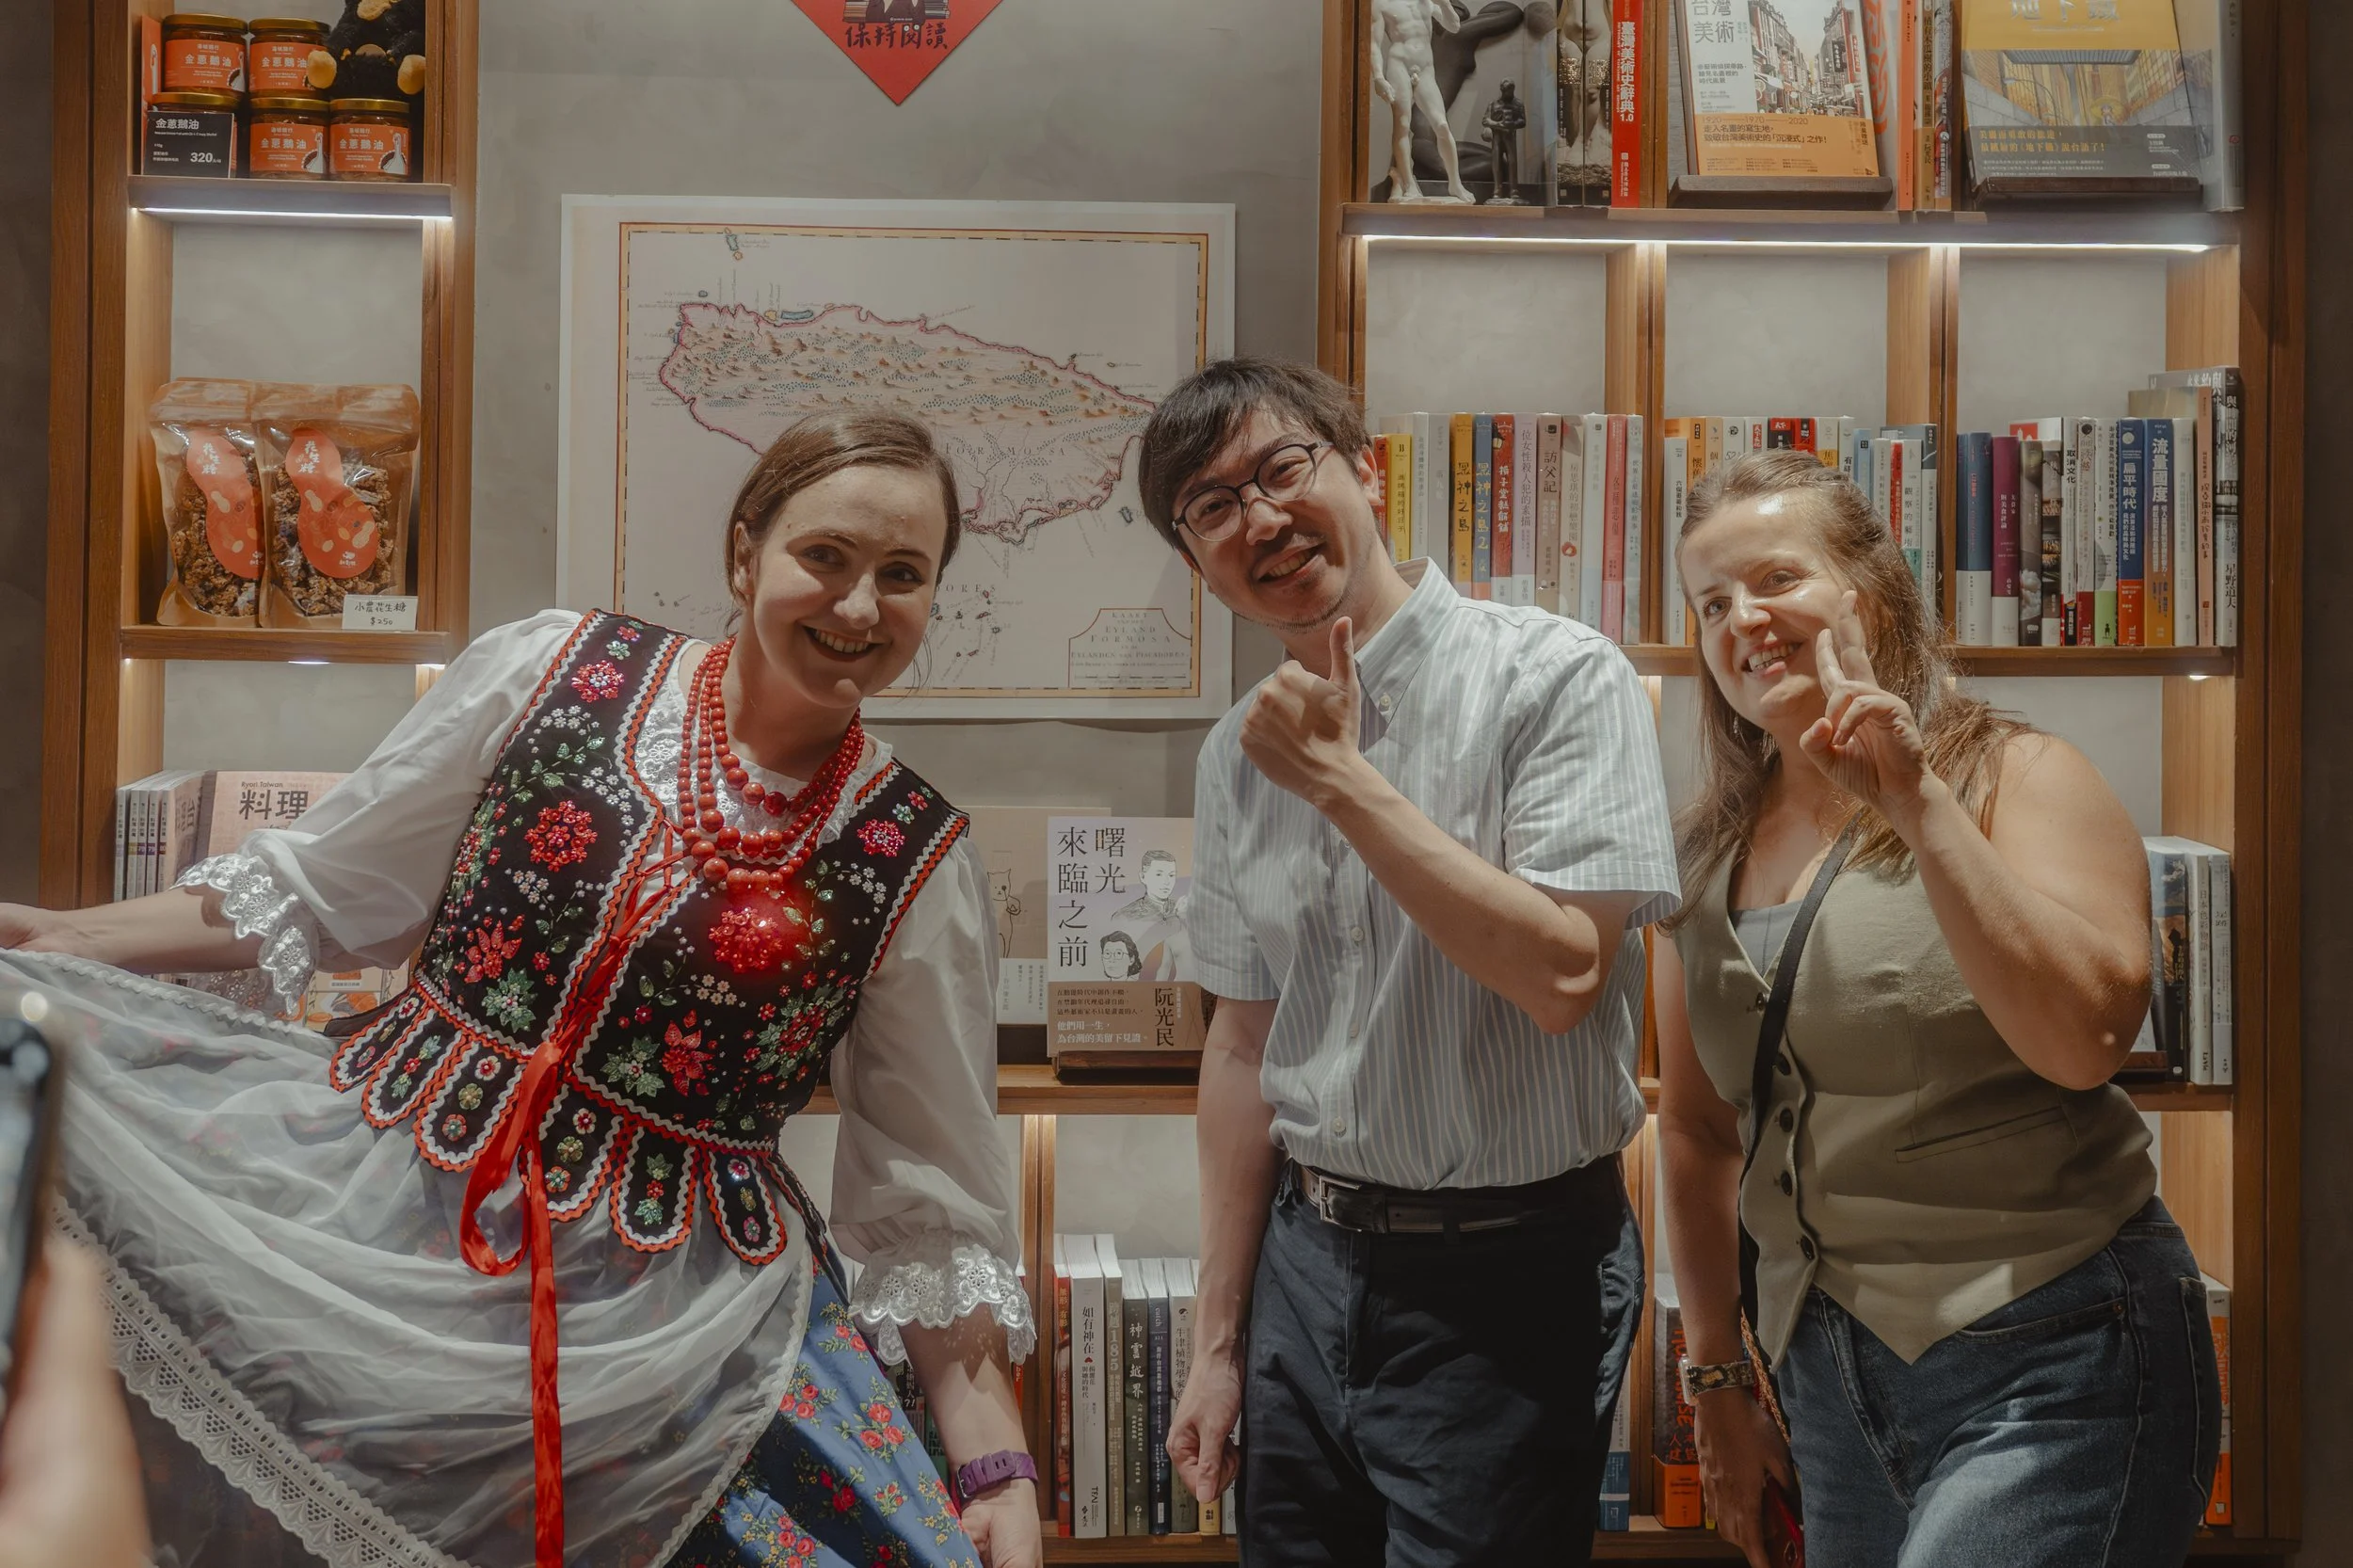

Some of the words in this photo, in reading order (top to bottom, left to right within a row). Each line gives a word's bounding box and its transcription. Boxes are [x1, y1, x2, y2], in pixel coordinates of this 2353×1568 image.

[845, 22, 948, 49] 保持閱讀
[1694, 21, 1734, 43] 美術
[1620, 114, 1634, 122] 1.0
[190, 152, 213, 163] 320
[201, 442, 221, 475] 花生糖
[298, 440, 321, 474] 花生糖
[1544, 451, 1558, 493] 訪父記
[2066, 450, 2076, 484] 取消文化
[2123, 462, 2137, 509] 扁平時代
[355, 601, 407, 613] 小農花生糖
[1090, 634, 1171, 643] FORMOSA
[241, 780, 258, 789] Ryori
[239, 789, 310, 820] 料理
[1094, 826, 1126, 894] 曙光
[1056, 825, 1089, 968] 來臨之前
[1057, 1020, 1110, 1032] 他們用一生，
[1155, 987, 1175, 1048] 阮光民
[1082, 1306, 1095, 1354] 如有神在
